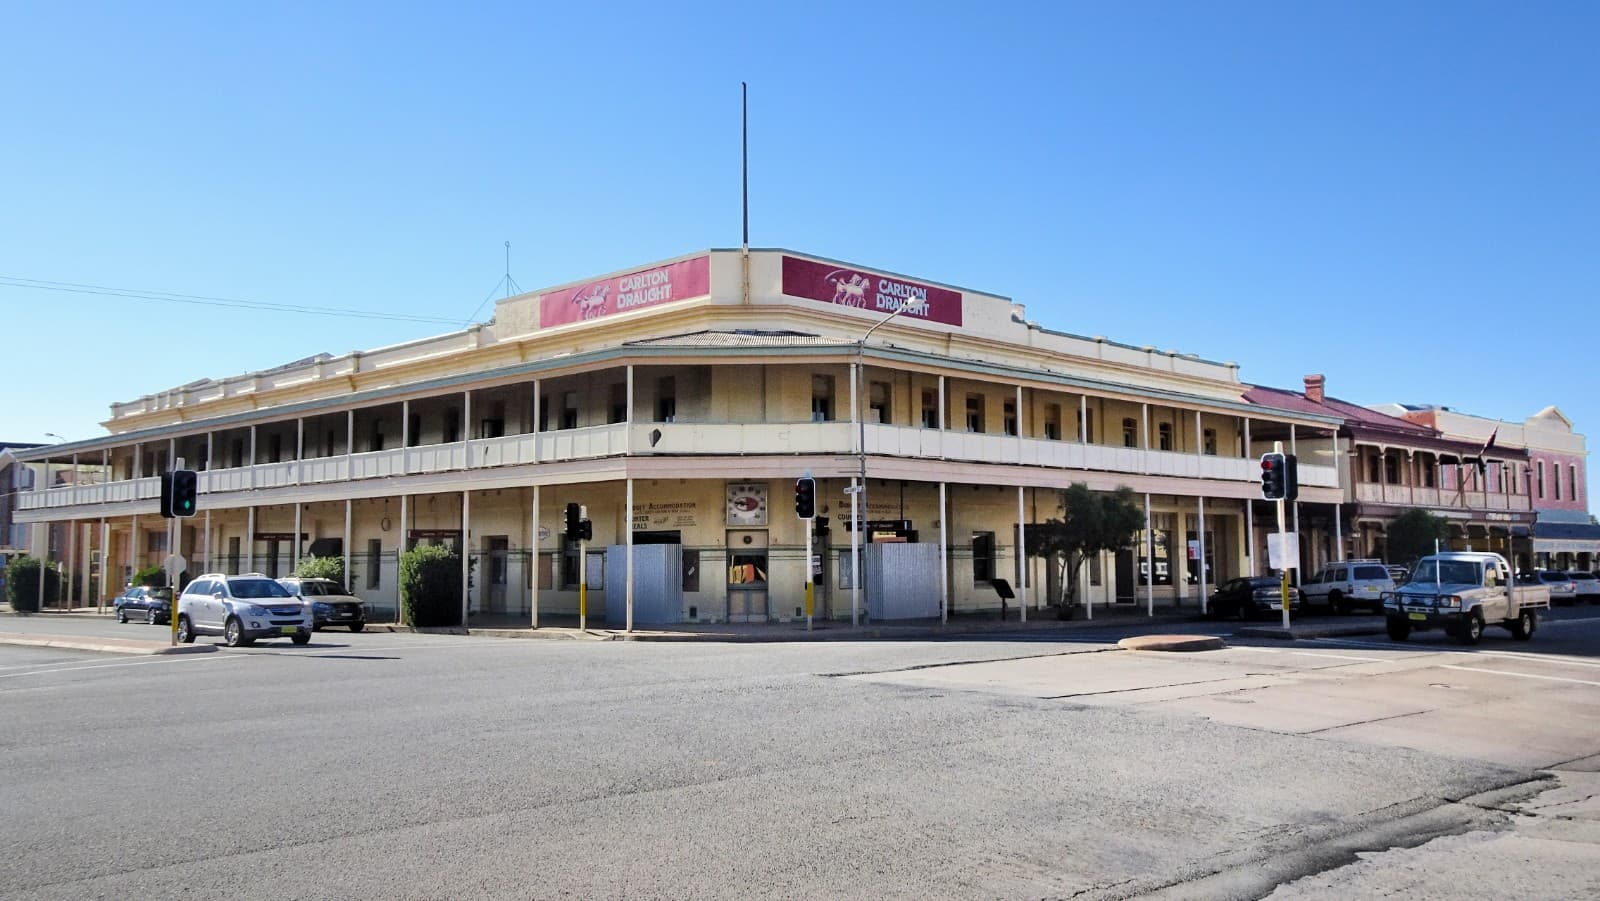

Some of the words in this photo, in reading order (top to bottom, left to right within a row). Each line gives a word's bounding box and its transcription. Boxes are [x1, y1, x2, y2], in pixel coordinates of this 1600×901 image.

[620, 270, 669, 292] CARLTON
[879, 279, 927, 301] CARLTON
[617, 284, 672, 309] DRAUGHT
[876, 293, 930, 316] DRAGHT
